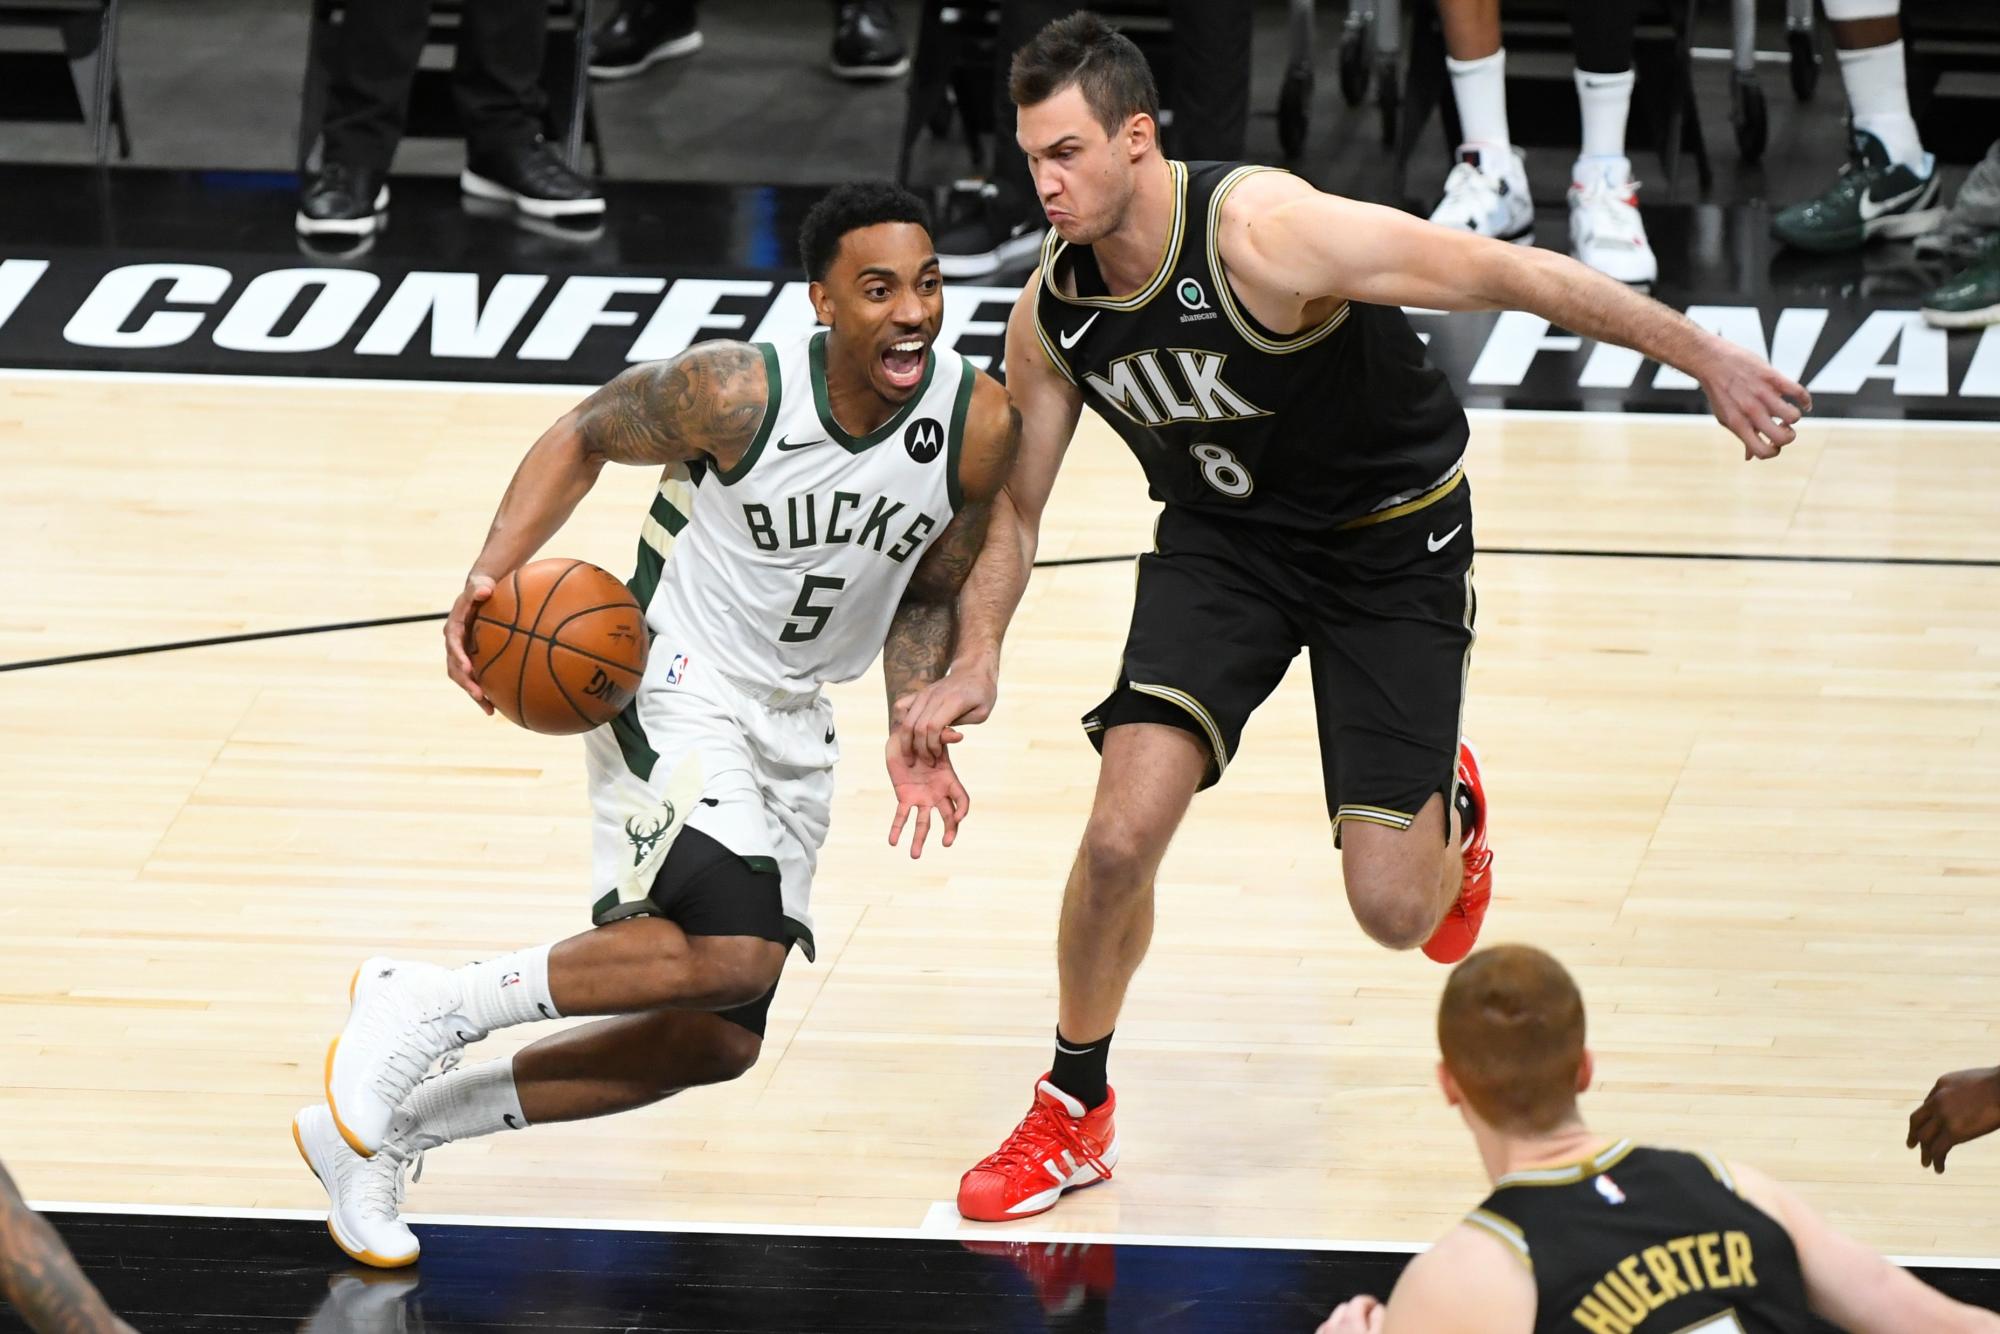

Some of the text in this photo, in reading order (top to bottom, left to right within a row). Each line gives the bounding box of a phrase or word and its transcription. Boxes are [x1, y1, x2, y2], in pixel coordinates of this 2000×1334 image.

[1179, 311, 1218, 323] sharecare
[1081, 347, 1276, 428] MLK
[1189, 442, 1254, 498] 8
[742, 490, 937, 563] BUCKS
[778, 573, 846, 643] 5
[1571, 1230, 1759, 1334] HUERTER
